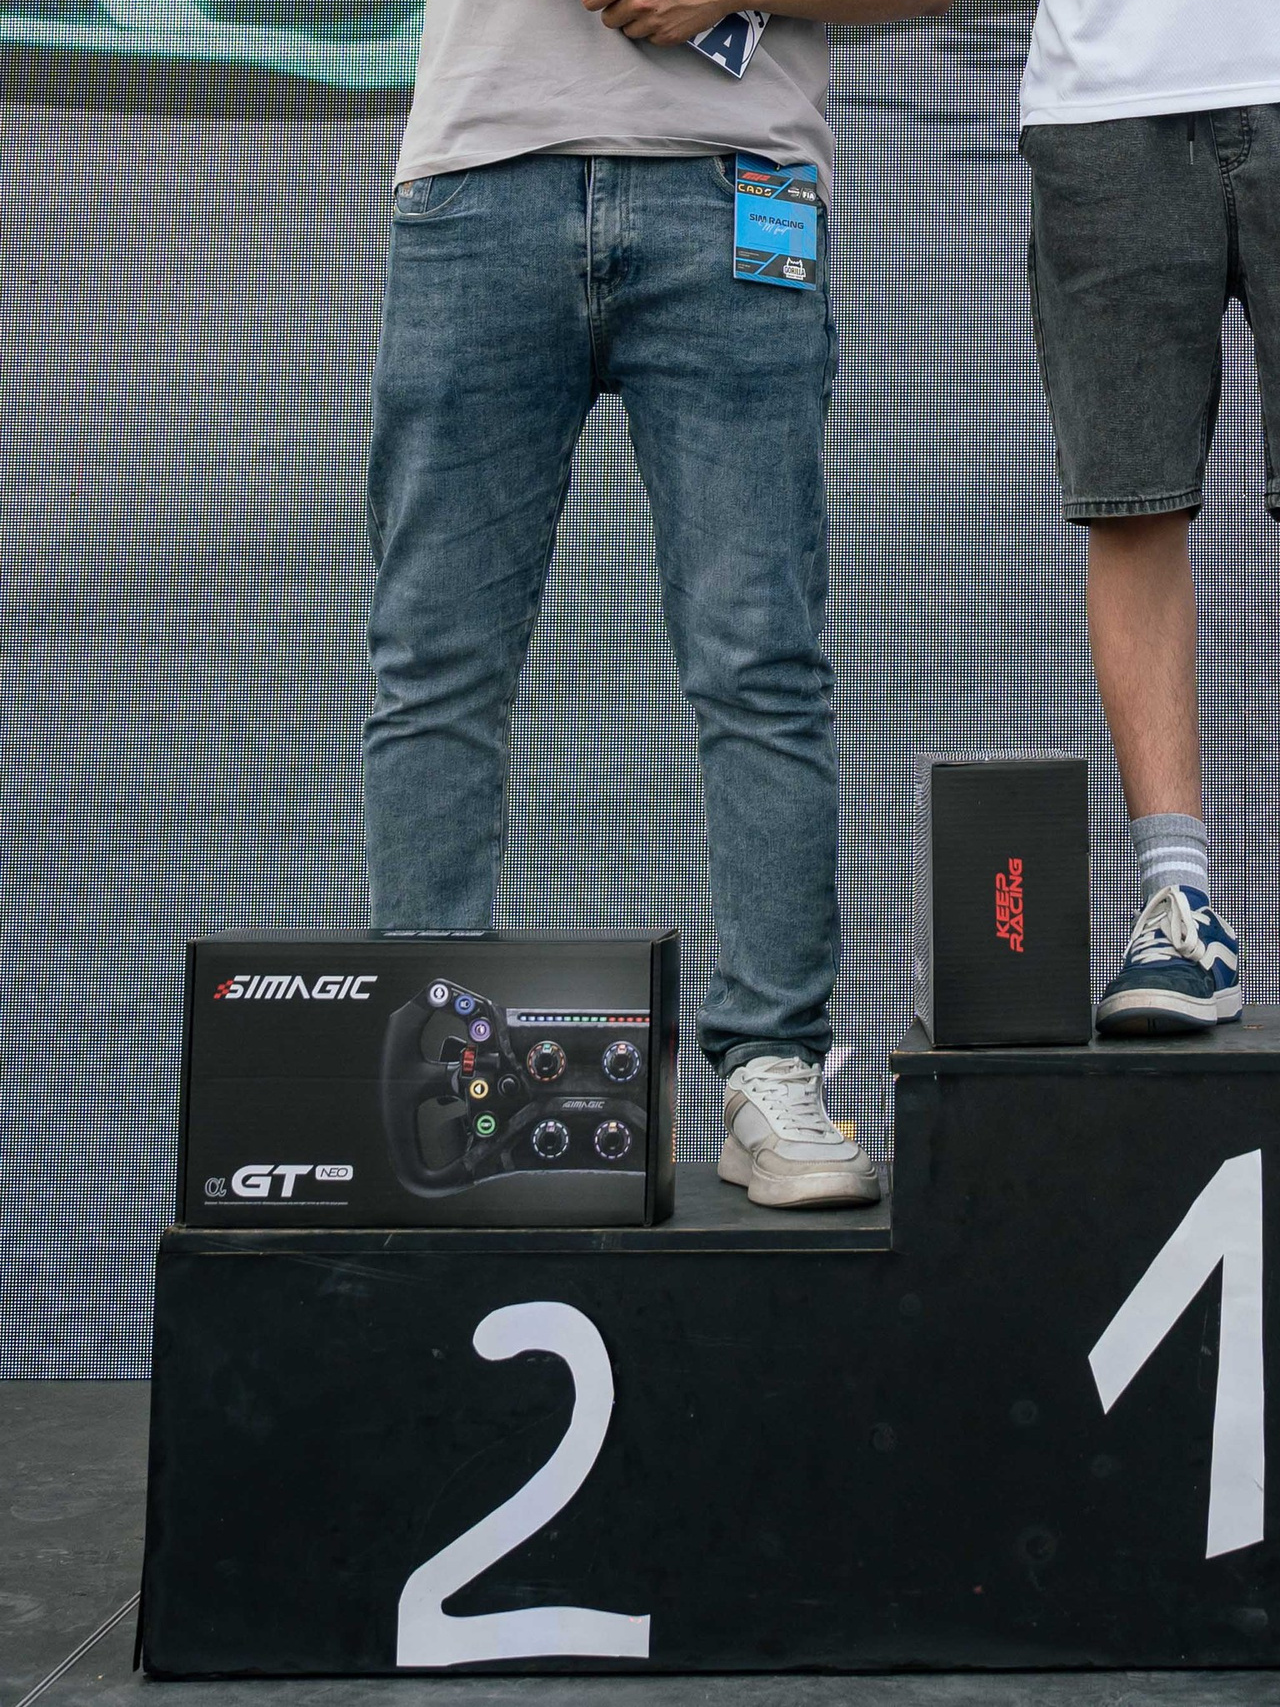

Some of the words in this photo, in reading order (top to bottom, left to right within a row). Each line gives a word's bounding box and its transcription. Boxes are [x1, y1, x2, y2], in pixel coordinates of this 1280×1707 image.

[738, 183, 772, 197] CADS
[749, 213, 767, 223] SIM
[768, 216, 805, 230] RACING
[995, 872, 1010, 939] KEEP
[1008, 857, 1024, 953] RACING
[214, 975, 379, 1000] SIMAGIC
[231, 1164, 314, 1198] GT
[320, 1167, 349, 1178] NEO
[1088, 1149, 1264, 1558] 1
[397, 1302, 650, 1666] 2
